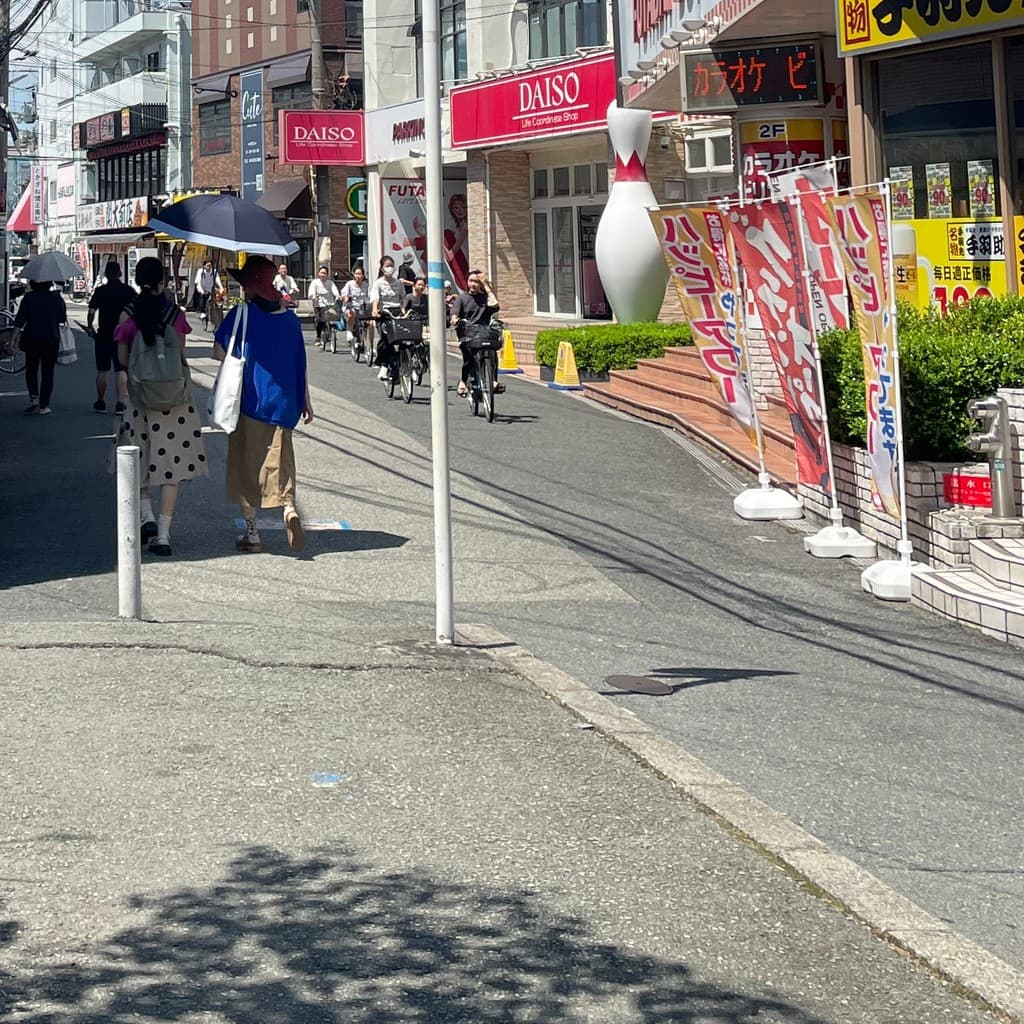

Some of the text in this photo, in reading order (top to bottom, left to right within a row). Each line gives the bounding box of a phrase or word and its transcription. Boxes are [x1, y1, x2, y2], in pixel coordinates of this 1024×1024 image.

[693, 57, 766, 96] カラオケ
[519, 72, 580, 112] DAISO
[293, 126, 355, 141] DAISO
[760, 124, 785, 138] 2F
[389, 185, 426, 197] FUTA
[966, 234, 1005, 256] 手羽助
